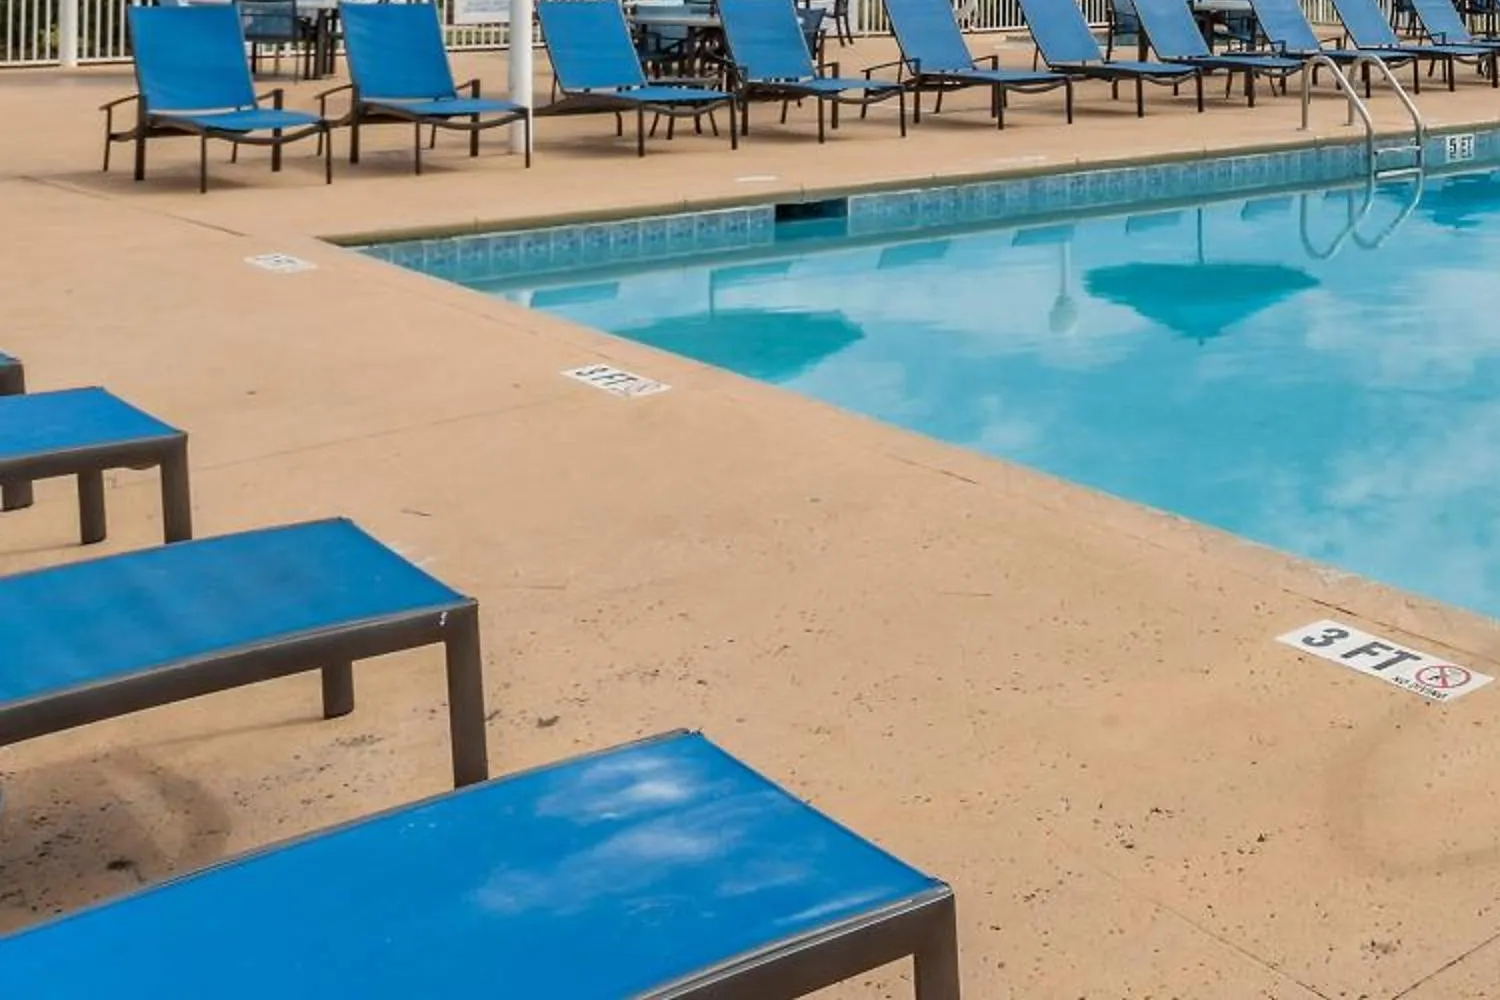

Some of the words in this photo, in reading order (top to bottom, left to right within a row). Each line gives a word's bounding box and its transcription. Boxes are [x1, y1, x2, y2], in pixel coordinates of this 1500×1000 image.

[1449, 138, 1457, 157] 5
[1301, 627, 1350, 648] 3
[1340, 640, 1422, 671] FT
